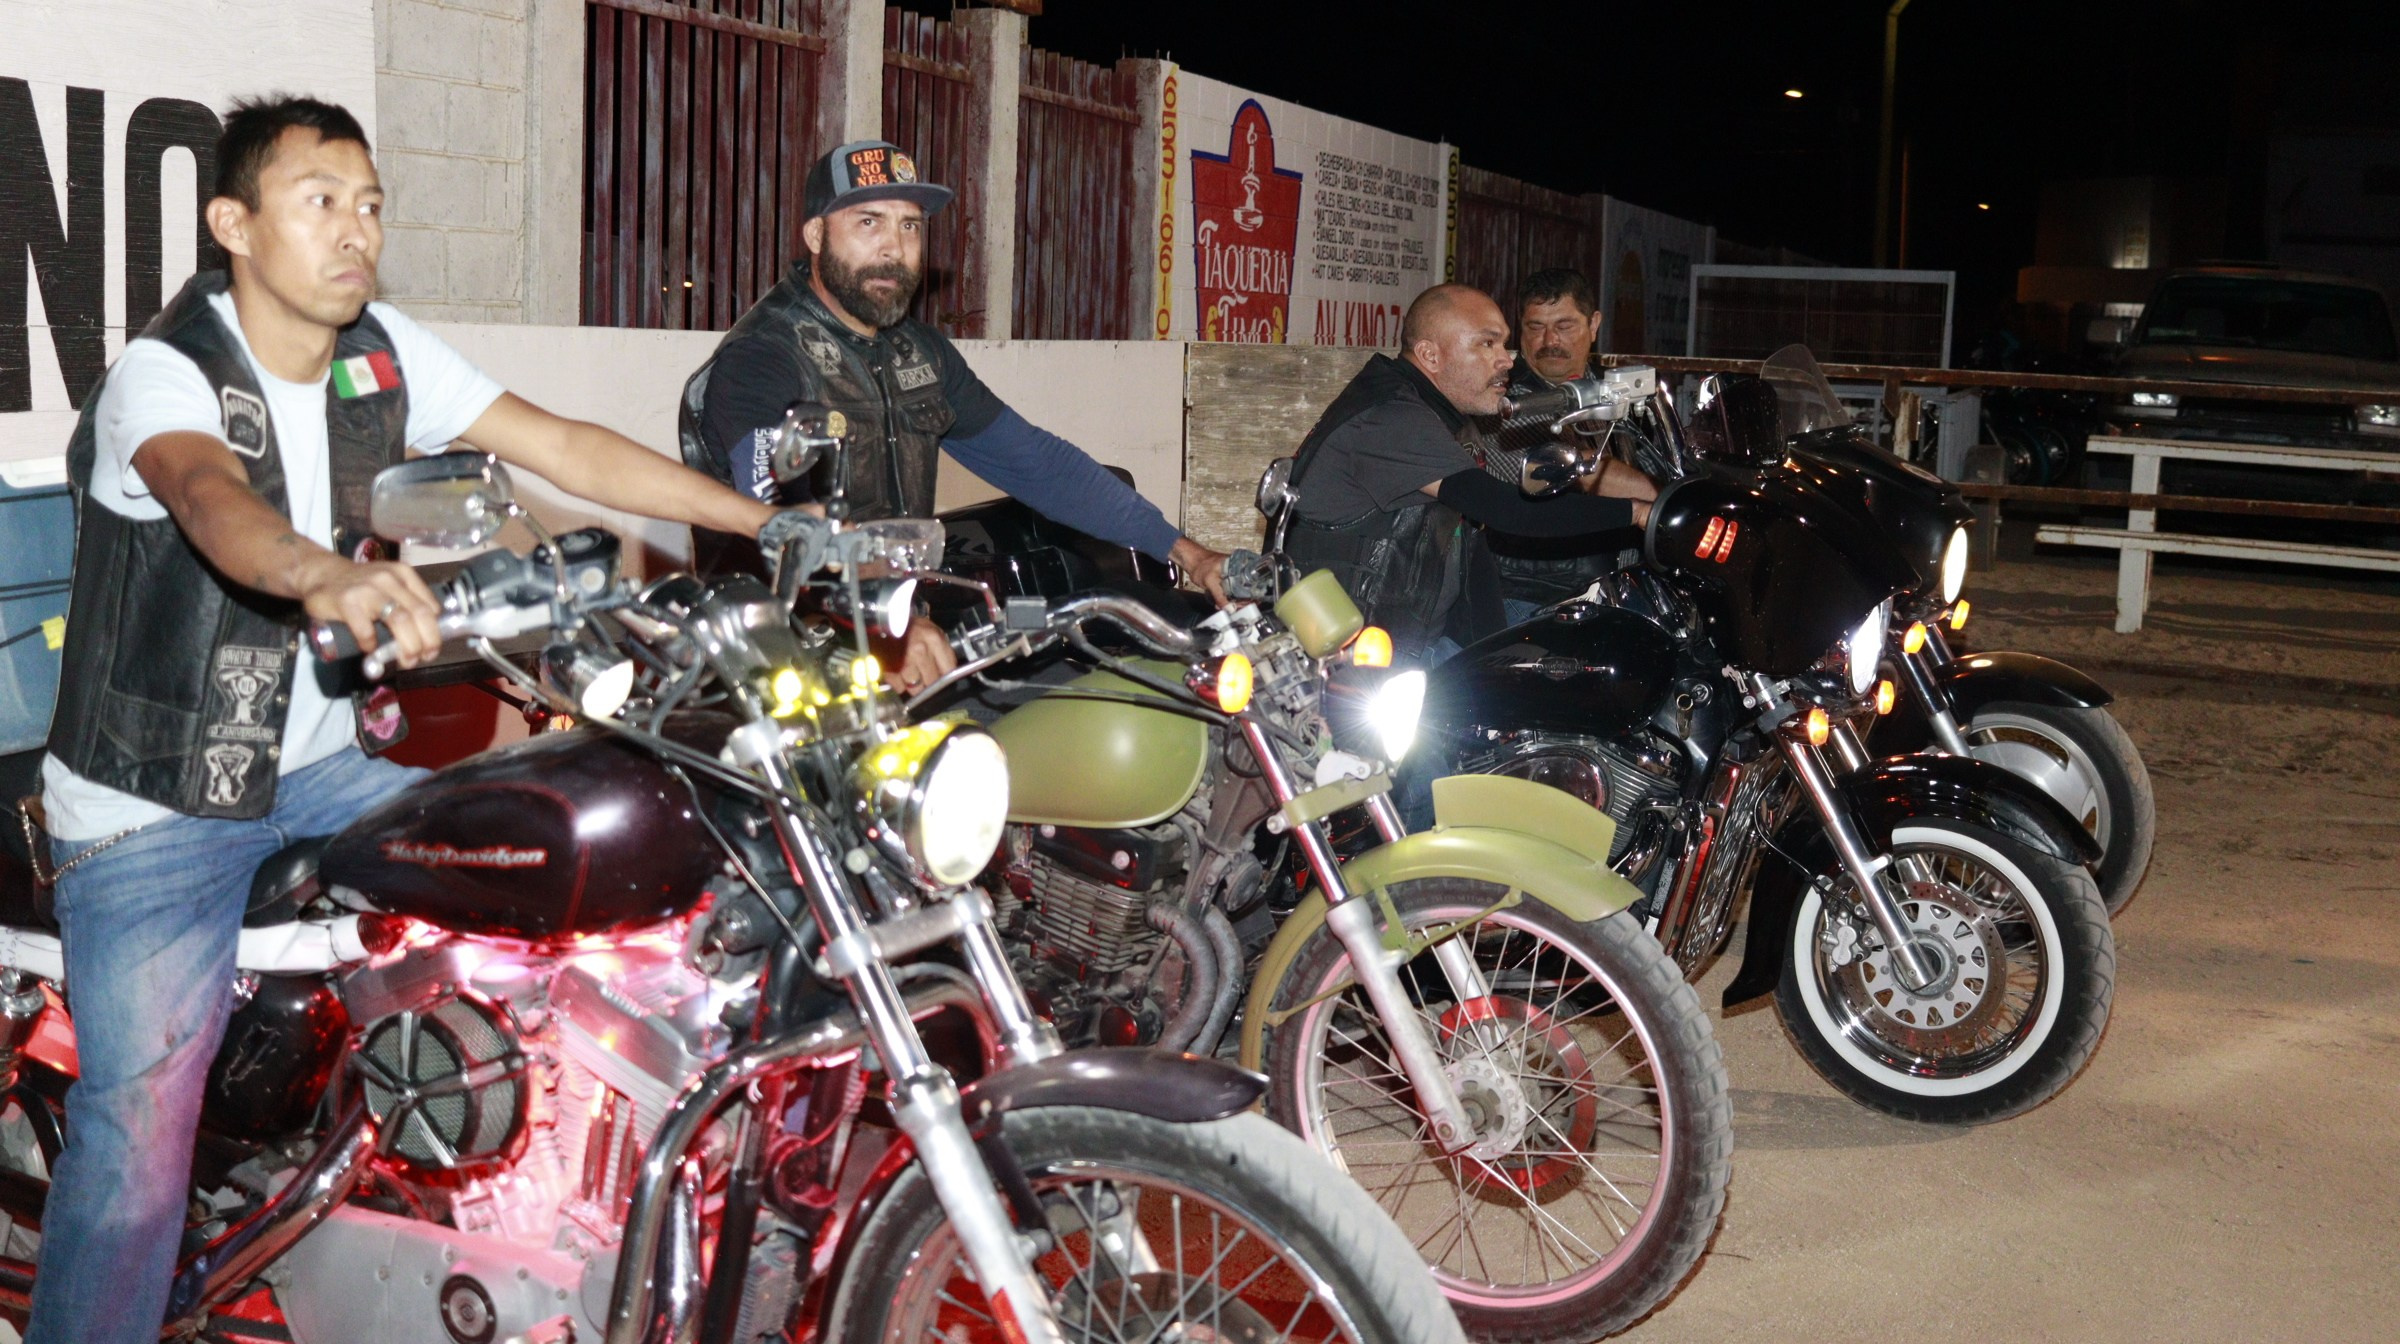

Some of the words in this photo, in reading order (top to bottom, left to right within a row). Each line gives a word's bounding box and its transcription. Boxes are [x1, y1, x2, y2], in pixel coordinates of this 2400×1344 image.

[852, 149, 885, 165] GRU
[1199, 219, 1290, 304] TAQUERIA
[1315, 264, 1325, 280] HOT
[1327, 265, 1344, 282] CAKES
[1314, 299, 1337, 346] AV
[1345, 301, 1386, 348] KINO
